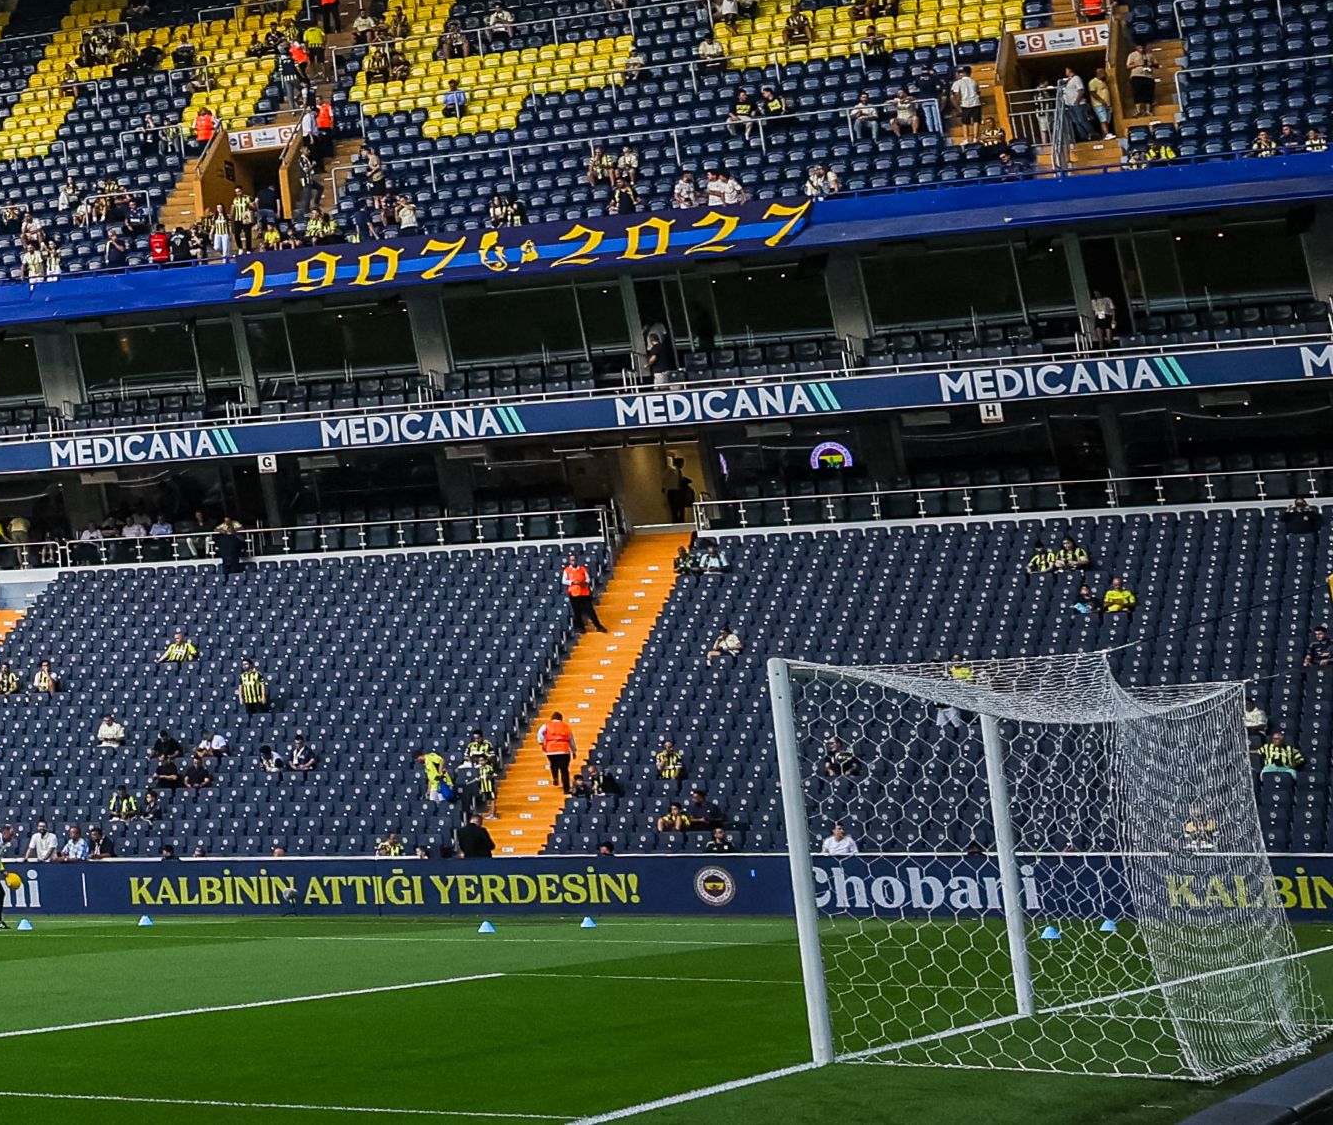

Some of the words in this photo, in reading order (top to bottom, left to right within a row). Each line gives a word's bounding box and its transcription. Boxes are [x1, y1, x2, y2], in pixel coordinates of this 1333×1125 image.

[1028, 36, 1042, 49] G
[1081, 29, 1096, 43] H
[235, 236, 466, 299] 1907
[553, 200, 811, 268] 2027
[50, 431, 218, 467] MEDICANA
[321, 407, 503, 448] MEDICANA
[615, 383, 815, 426] MEDICANA
[939, 357, 1164, 402] MEDICANA
[130, 869, 295, 905] KALBİNİN
[304, 868, 424, 905] ATTIĞI
[431, 866, 641, 904] YERDESİN!
